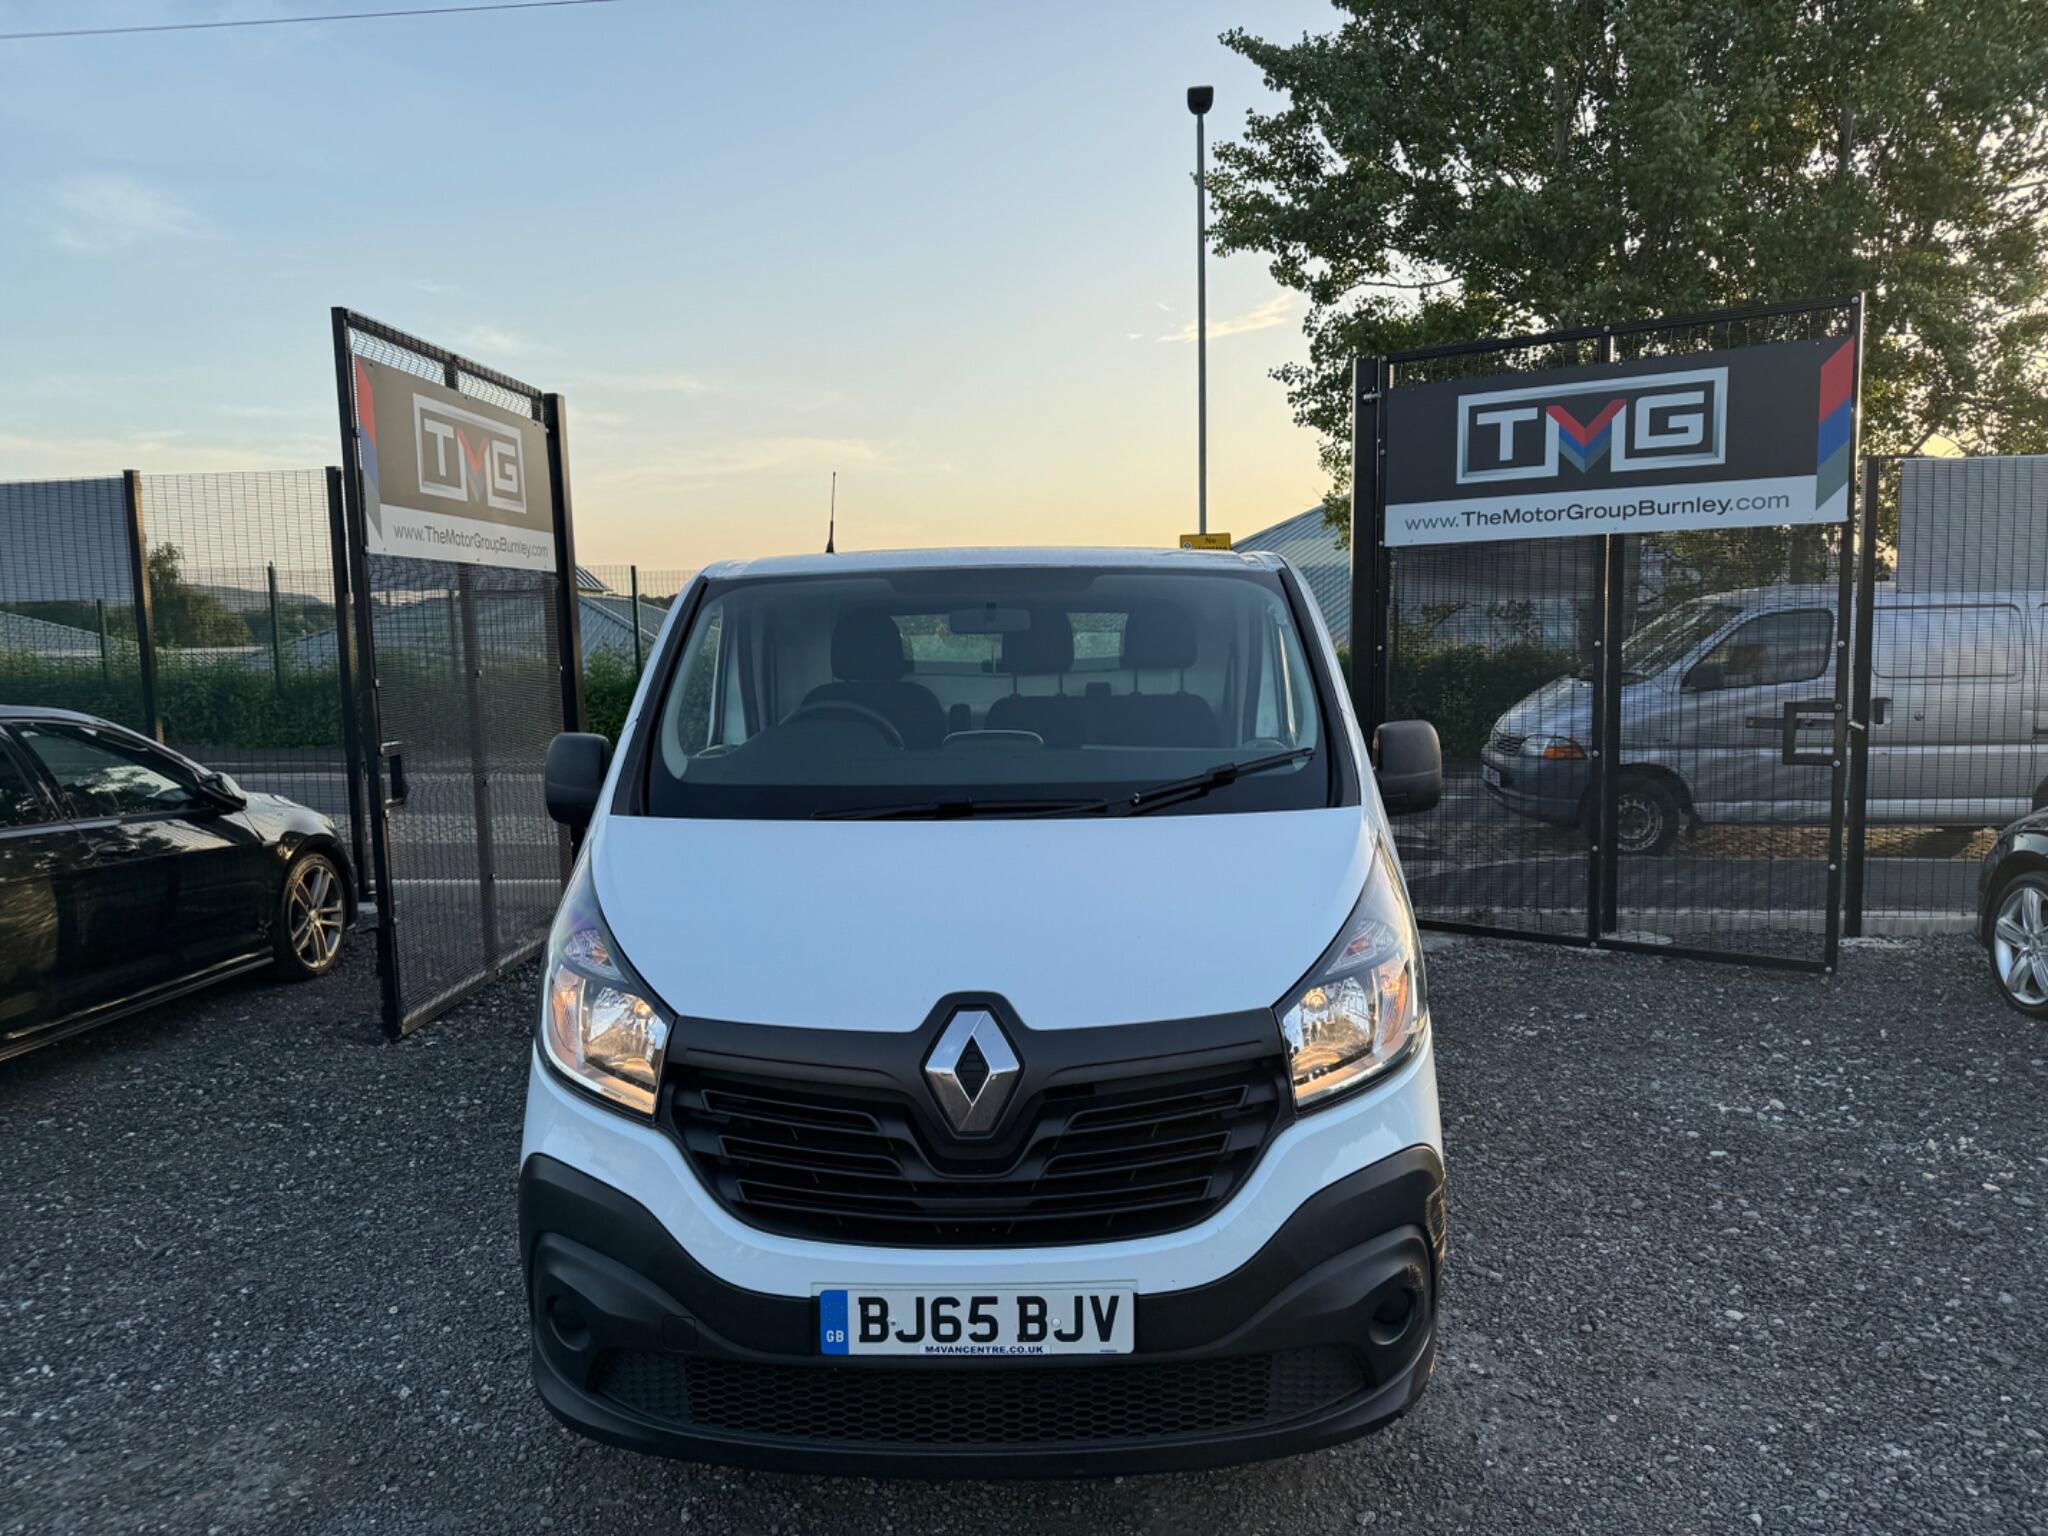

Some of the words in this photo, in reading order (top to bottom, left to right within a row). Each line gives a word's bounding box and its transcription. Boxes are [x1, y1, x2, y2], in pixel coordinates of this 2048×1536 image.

[1475, 389, 1706, 477] TMG
[421, 416, 520, 506] TMG
[1404, 493, 1790, 531] www.TheMotorGroupBurnley.com
[393, 525, 549, 558] www.TheMotorGroupBurnley.com
[825, 1330, 845, 1343] GB
[858, 1295, 999, 1343] BJ65
[1016, 1295, 1120, 1343] BJV
[924, 1345, 1044, 1354] M4VANCENTRE.CO.UK
